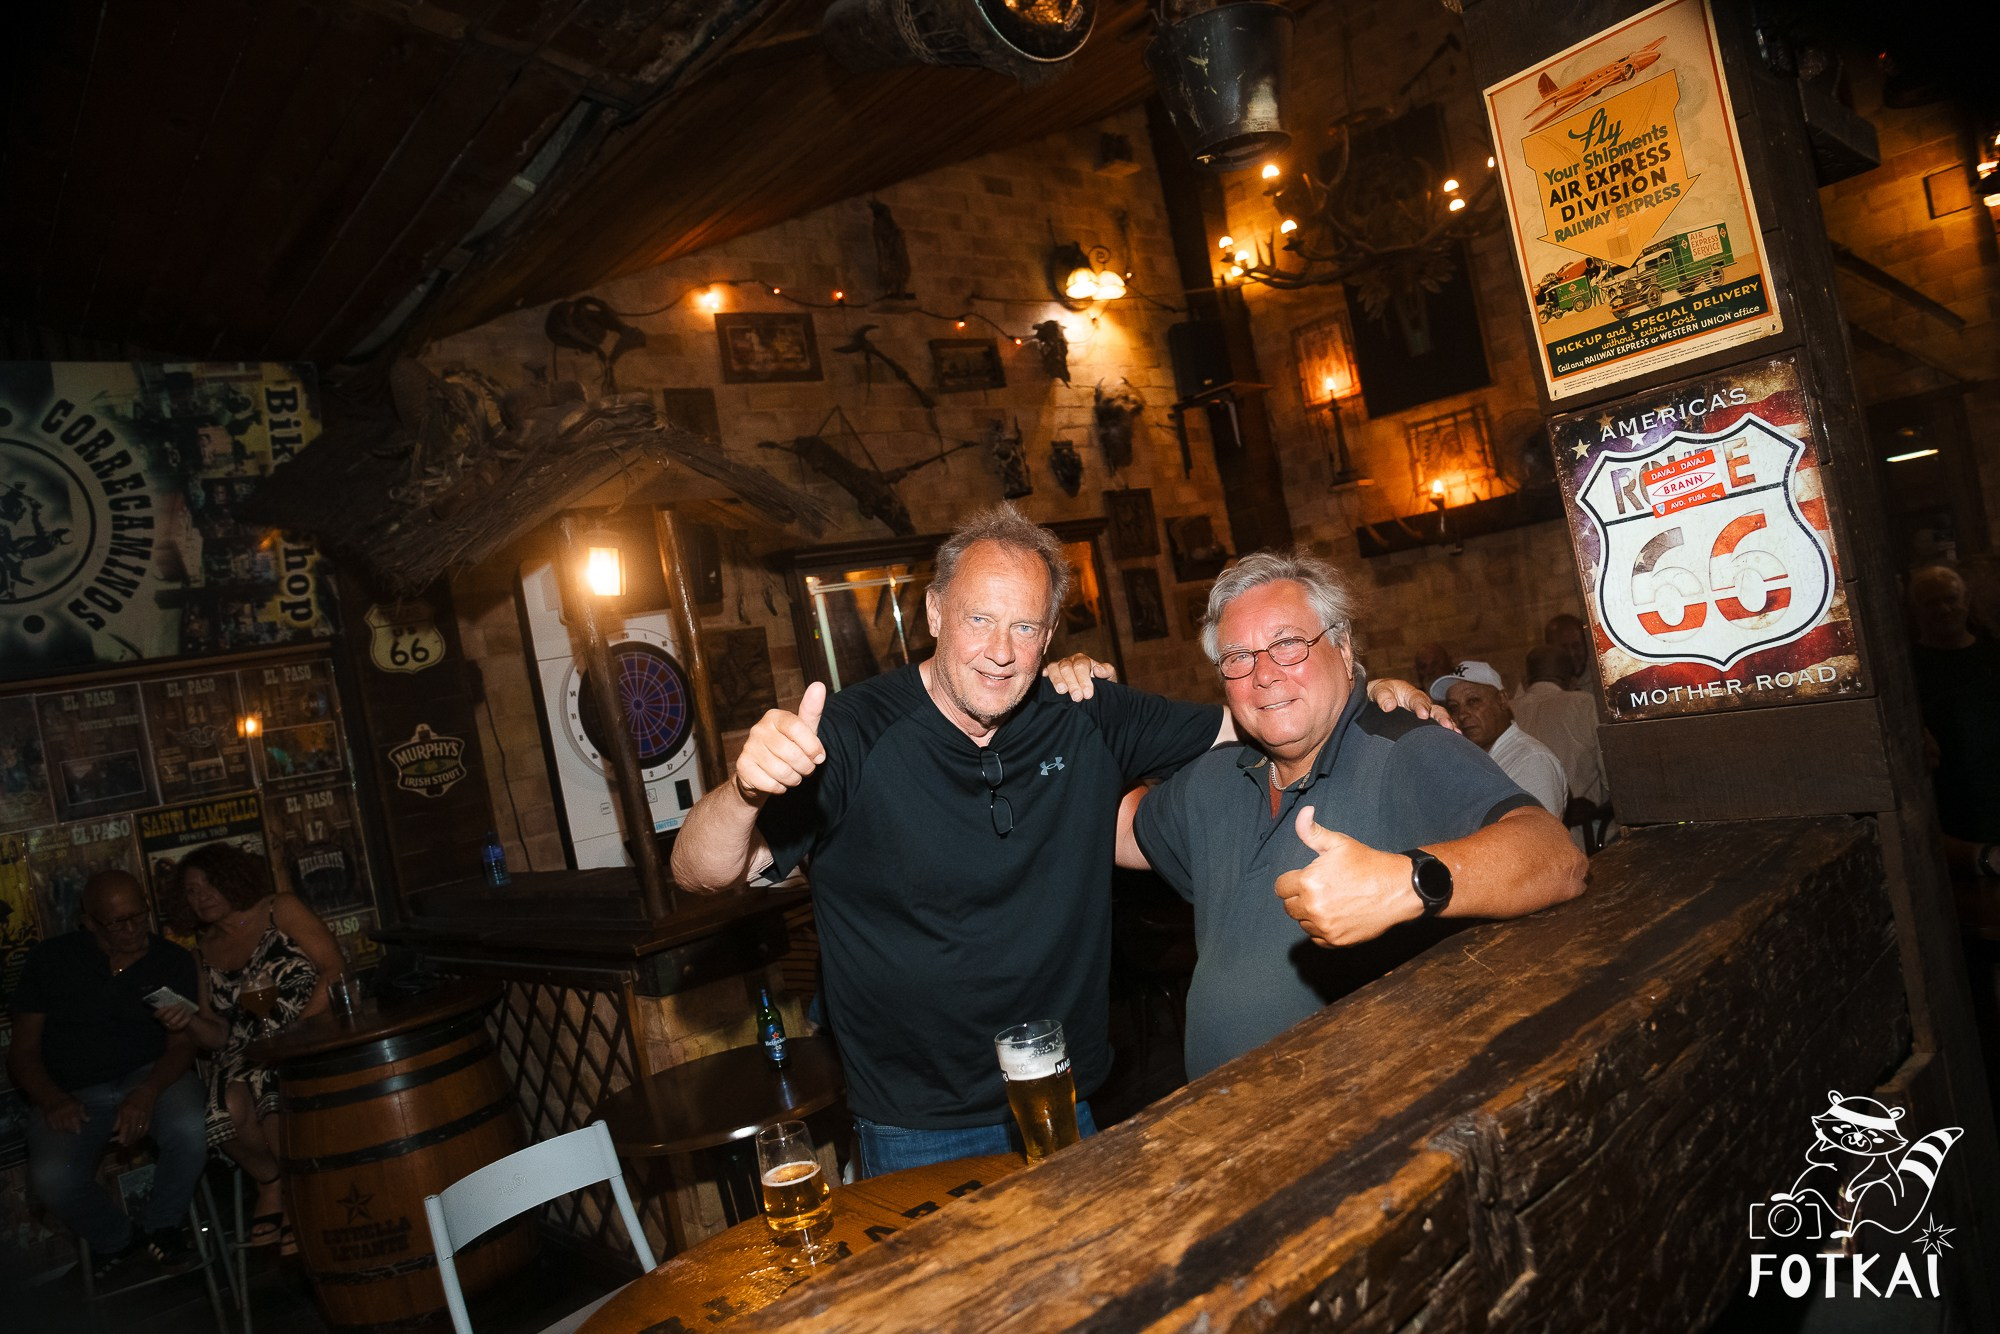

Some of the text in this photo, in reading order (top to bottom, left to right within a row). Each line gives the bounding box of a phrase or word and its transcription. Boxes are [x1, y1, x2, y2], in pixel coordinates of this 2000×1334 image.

[1544, 124, 1668, 185] Your Shipments
[1550, 142, 1671, 207] AIR EXPRESS
[1561, 167, 1667, 222] DIVISION
[1554, 183, 1681, 242] RAILWAY EXPRESS
[1690, 231, 1703, 241] AIR
[1691, 234, 1718, 249] EXPRESS
[1693, 242, 1720, 256] SERVICE
[1556, 281, 1759, 356] PICK-UP and SPECIAL DELIVERY
[1601, 313, 1696, 350] without extra cost
[1557, 304, 1760, 373] Call any RAILWAY EXPRESS or WESTERN UNION office
[264, 386, 304, 466] Bik
[1600, 387, 1747, 443] AMERICA'S
[1651, 456, 1706, 481] DAVAJ DAVAJ
[1663, 474, 1704, 496] BRANN
[41, 398, 155, 632] CORRECAMINOS
[1670, 492, 1707, 510] AVD. FUSA
[280, 528, 314, 624] hop
[1631, 508, 1792, 643] 66
[391, 638, 430, 666] 66
[187, 678, 216, 694] PASO
[283, 664, 312, 682] PASO
[1630, 666, 1837, 708] MOTHER ROAD
[84, 690, 116, 709] PASO
[396, 742, 459, 767] MURPHY'S
[405, 768, 461, 787] IRISH STOUT
[286, 791, 334, 814] EL PASO
[141, 796, 259, 838] SANTI CAMPILLO
[305, 820, 325, 842] 17
[72, 826, 90, 846] EL
[93, 819, 130, 842] PASO
